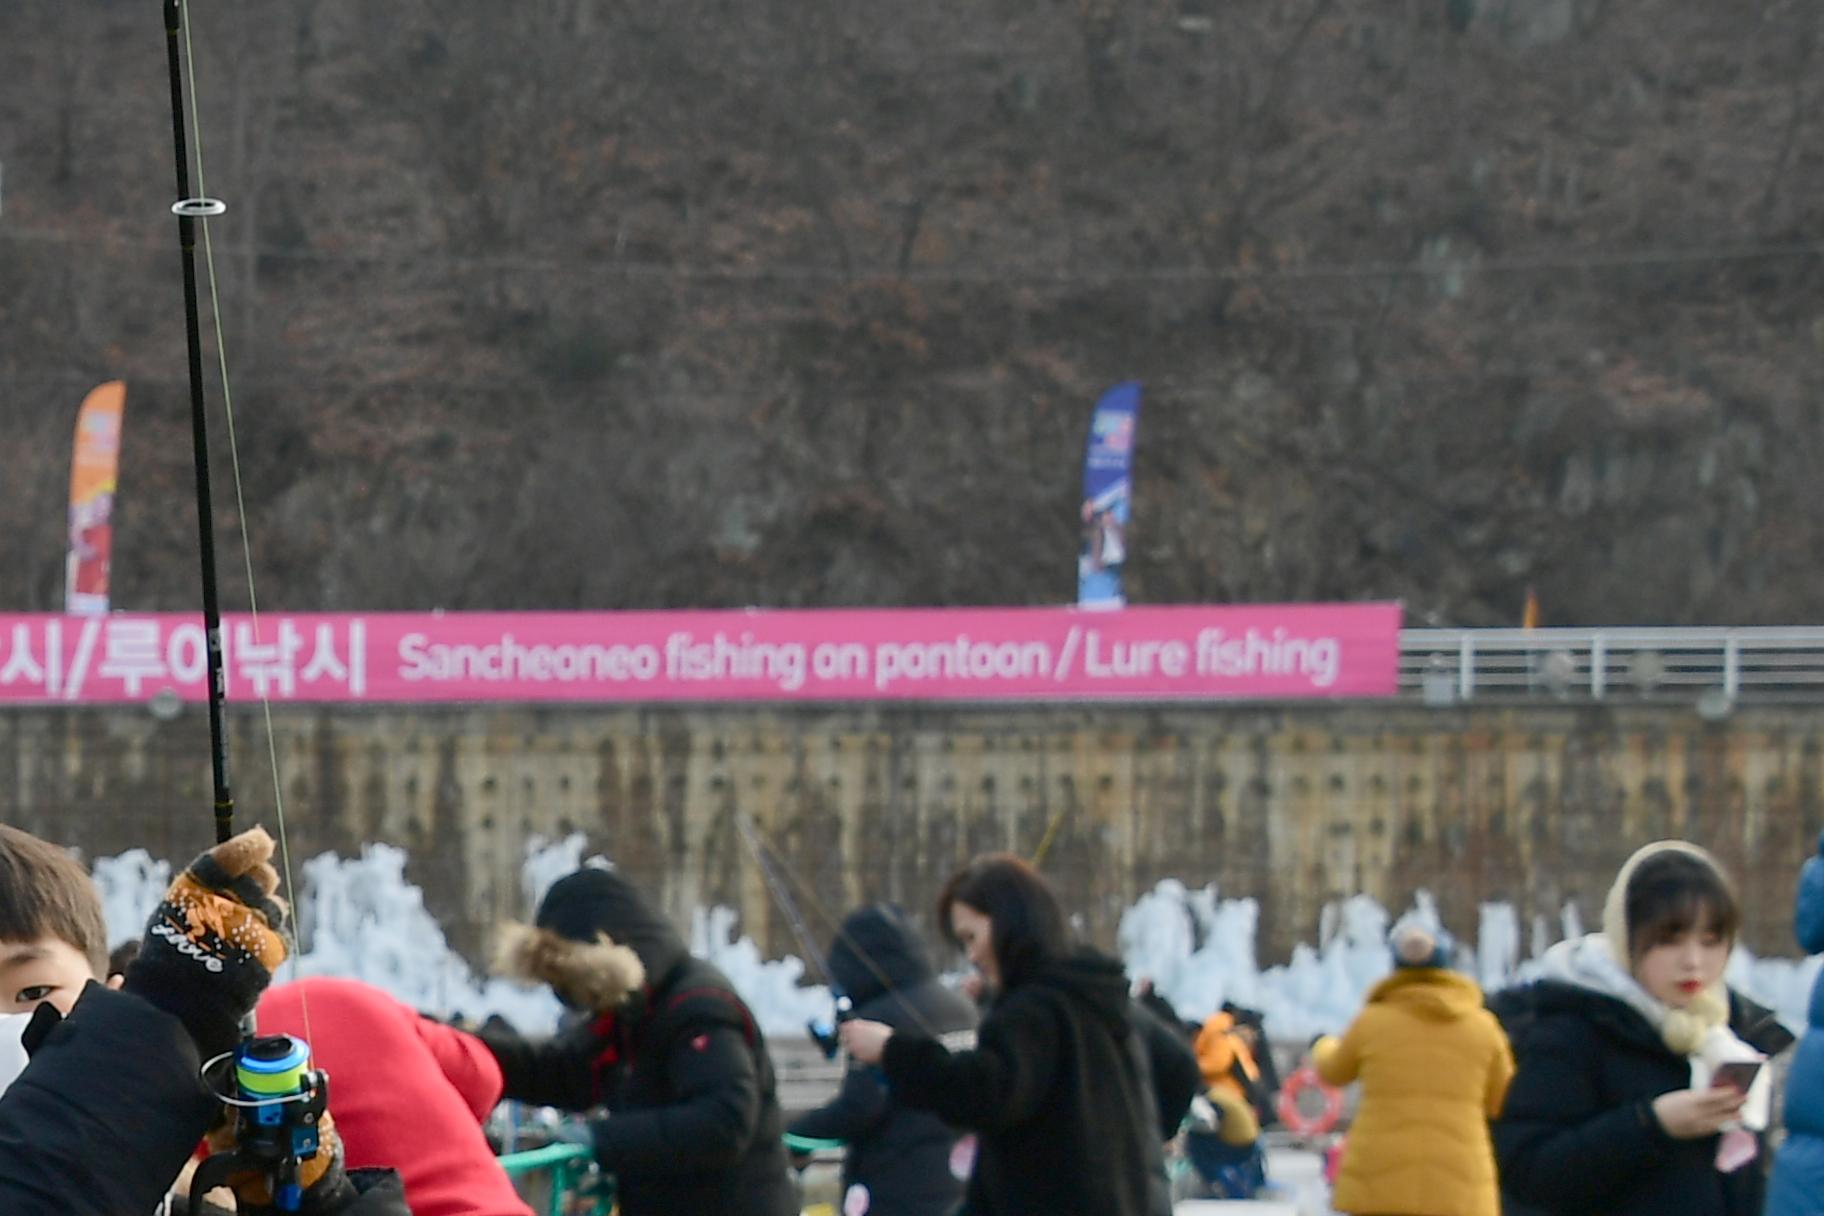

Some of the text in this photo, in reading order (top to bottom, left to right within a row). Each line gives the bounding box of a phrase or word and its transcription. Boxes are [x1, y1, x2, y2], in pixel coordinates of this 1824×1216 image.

[664, 631, 806, 690] fishing
[813, 643, 868, 680] on
[1196, 627, 1339, 687] fishing
